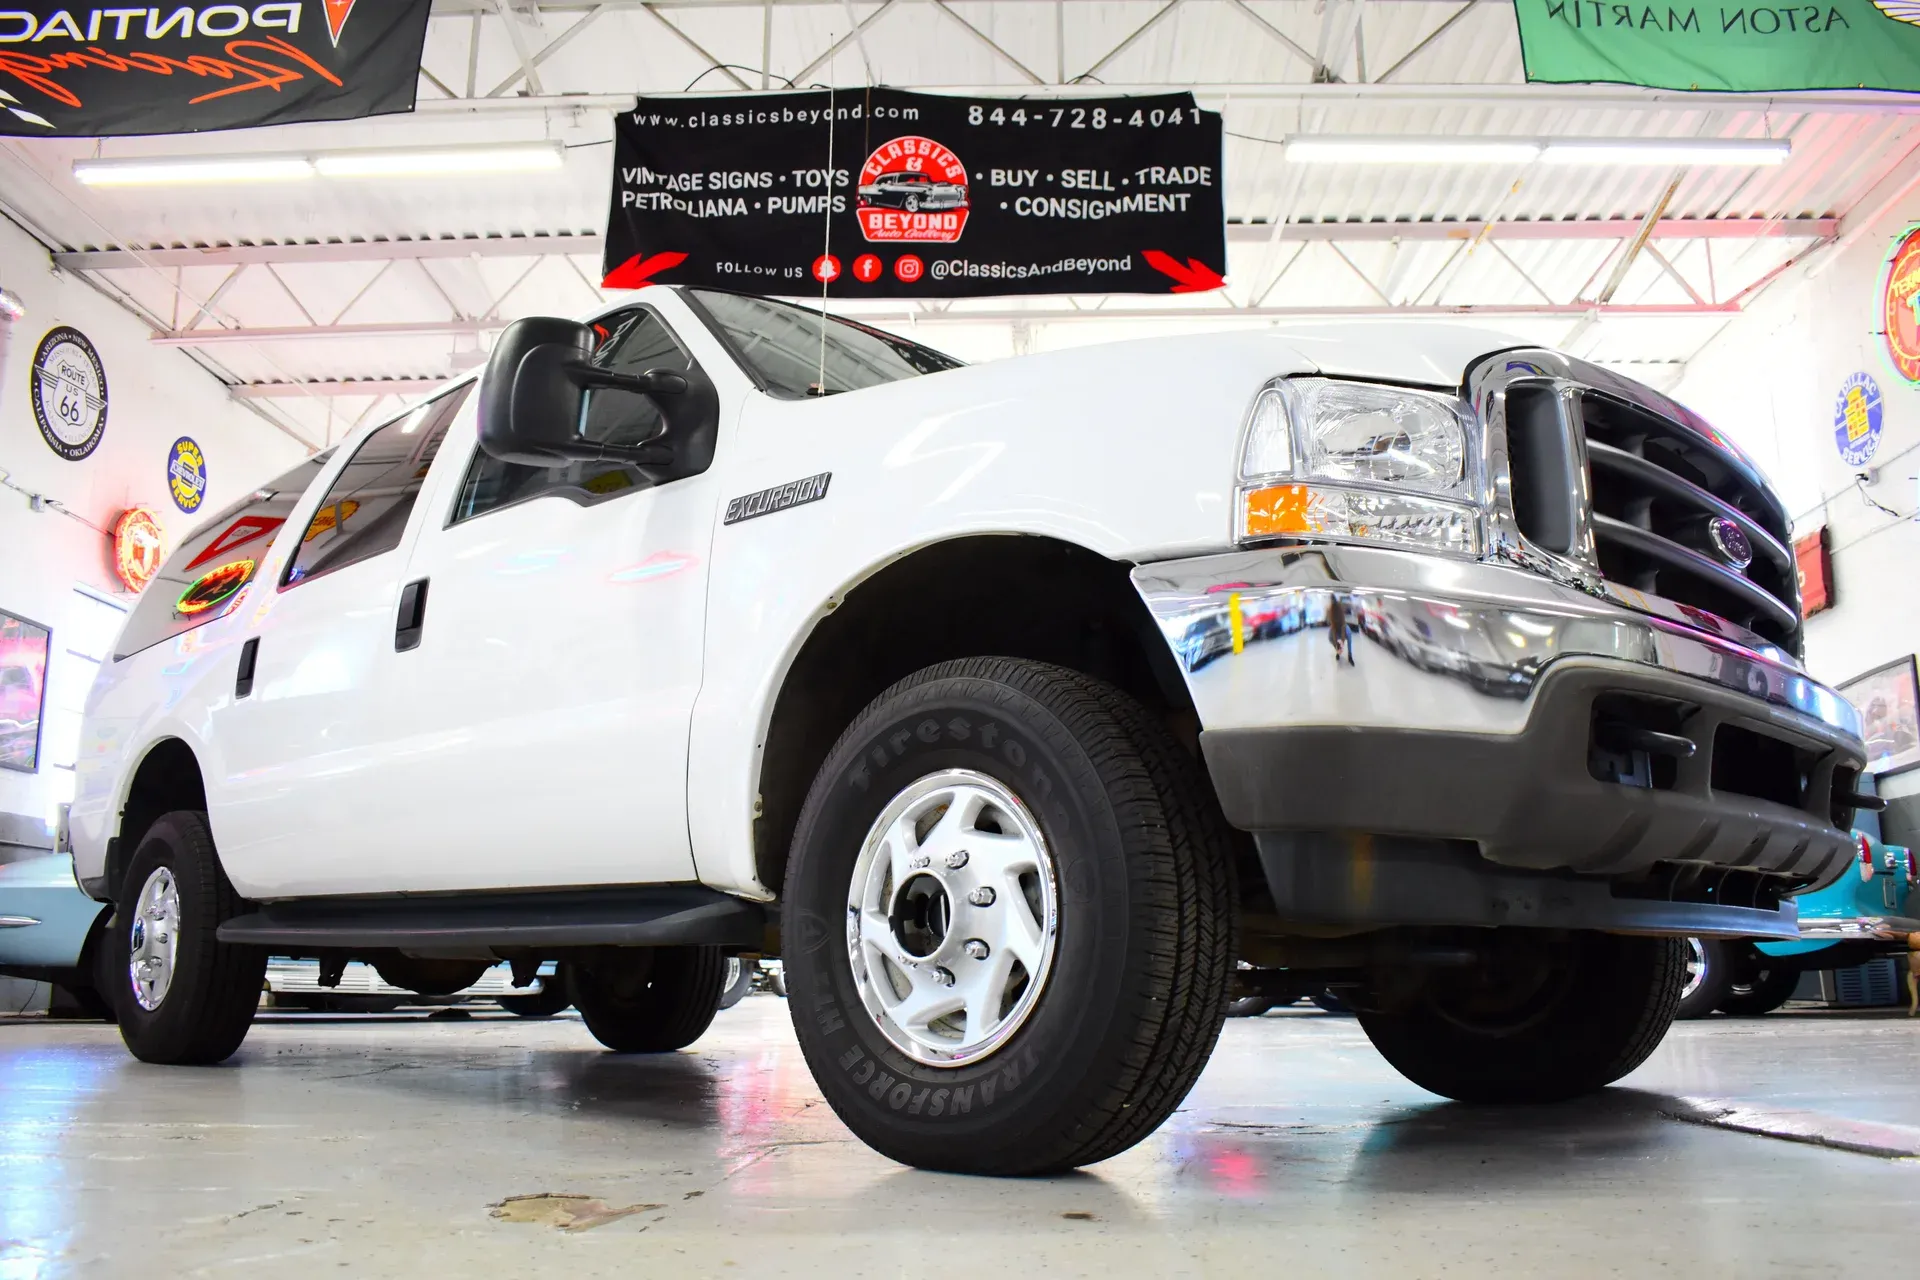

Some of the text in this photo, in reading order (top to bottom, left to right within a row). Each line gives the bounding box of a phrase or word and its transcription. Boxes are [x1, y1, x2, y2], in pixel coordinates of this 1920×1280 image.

[633, 104, 920, 128] www.classicsbeyond.com
[968, 105, 1201, 129] 844-728-4041
[866, 139, 963, 179] CLASSICS
[905, 156, 923, 171] &
[621, 167, 850, 192] VINTAGE SIGNS TOYS
[990, 166, 1212, 191] BUY SELL TRADE
[621, 190, 846, 218] PETROLIANA PUMPS
[1015, 193, 1191, 220] CONSIGNMENT
[869, 213, 958, 230] BEYOND
[716, 261, 803, 278] FOLLOW US
[930, 255, 1131, 280] @ClassicsAndBeyond
[61, 365, 85, 386] ROUTE
[65, 384, 79, 397] US
[1835, 373, 1876, 418] CADILLAC
[60, 395, 79, 422] 66
[34, 388, 103, 457] CALIFORNIA OKLAHOMA
[176, 440, 203, 467] SUPER
[171, 478, 201, 508] SERVICE
[725, 472, 829, 523] EXCURSION
[849, 716, 1071, 833] Firestone
[839, 1044, 1040, 1117] TRANSFORCE
